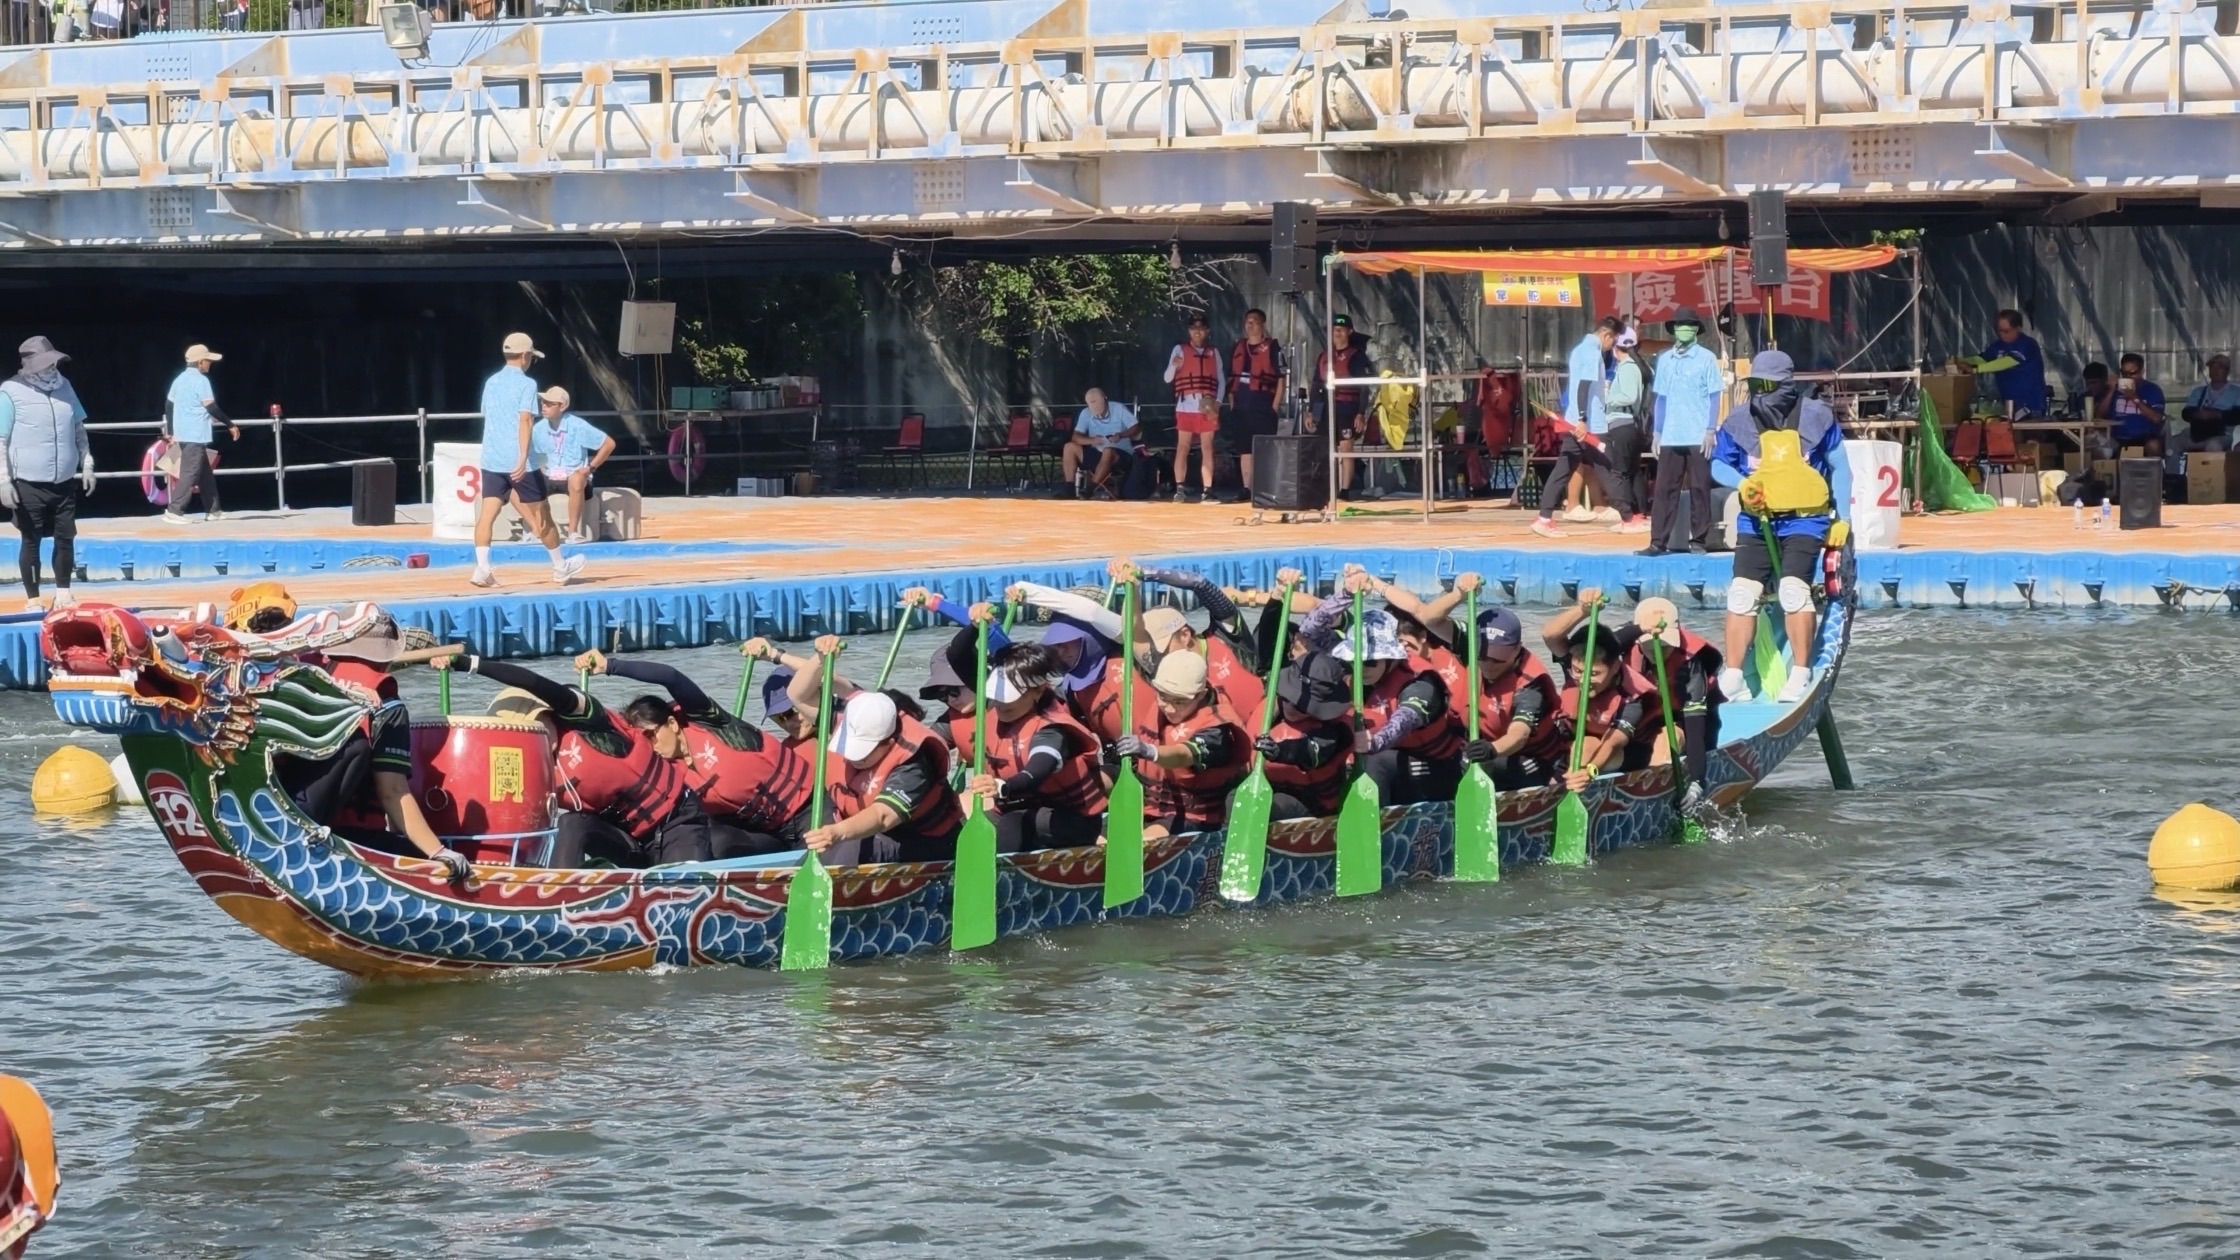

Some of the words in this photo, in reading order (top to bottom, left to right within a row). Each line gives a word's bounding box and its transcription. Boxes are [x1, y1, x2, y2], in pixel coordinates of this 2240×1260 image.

[456, 465, 480, 502] 3
[1877, 465, 1900, 507] 2
[155, 793, 207, 836] 12
